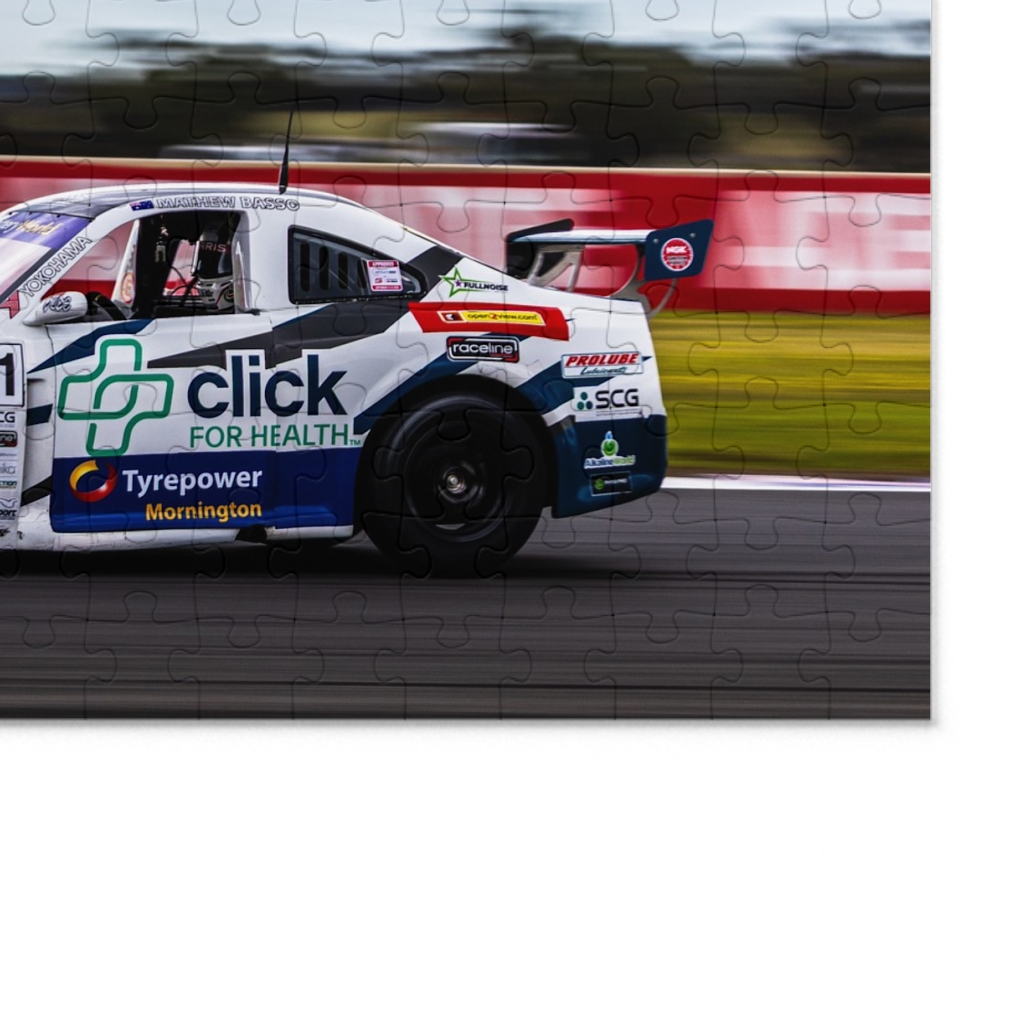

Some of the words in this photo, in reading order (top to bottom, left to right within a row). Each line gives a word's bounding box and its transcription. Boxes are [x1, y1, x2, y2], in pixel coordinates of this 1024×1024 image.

[156, 196, 236, 209] MATHEW
[239, 196, 301, 212] BASSO
[19, 234, 93, 298] YOKOHAMA
[463, 281, 509, 291] FULLNOISE
[452, 342, 514, 354] raceline
[565, 353, 640, 367] PROLUBE
[187, 354, 349, 419] click
[595, 388, 639, 409] SCG
[189, 426, 243, 448] FOR
[251, 423, 348, 447] HEALTH
[122, 470, 263, 498] Tyrepower
[145, 501, 263, 523] Mornington
